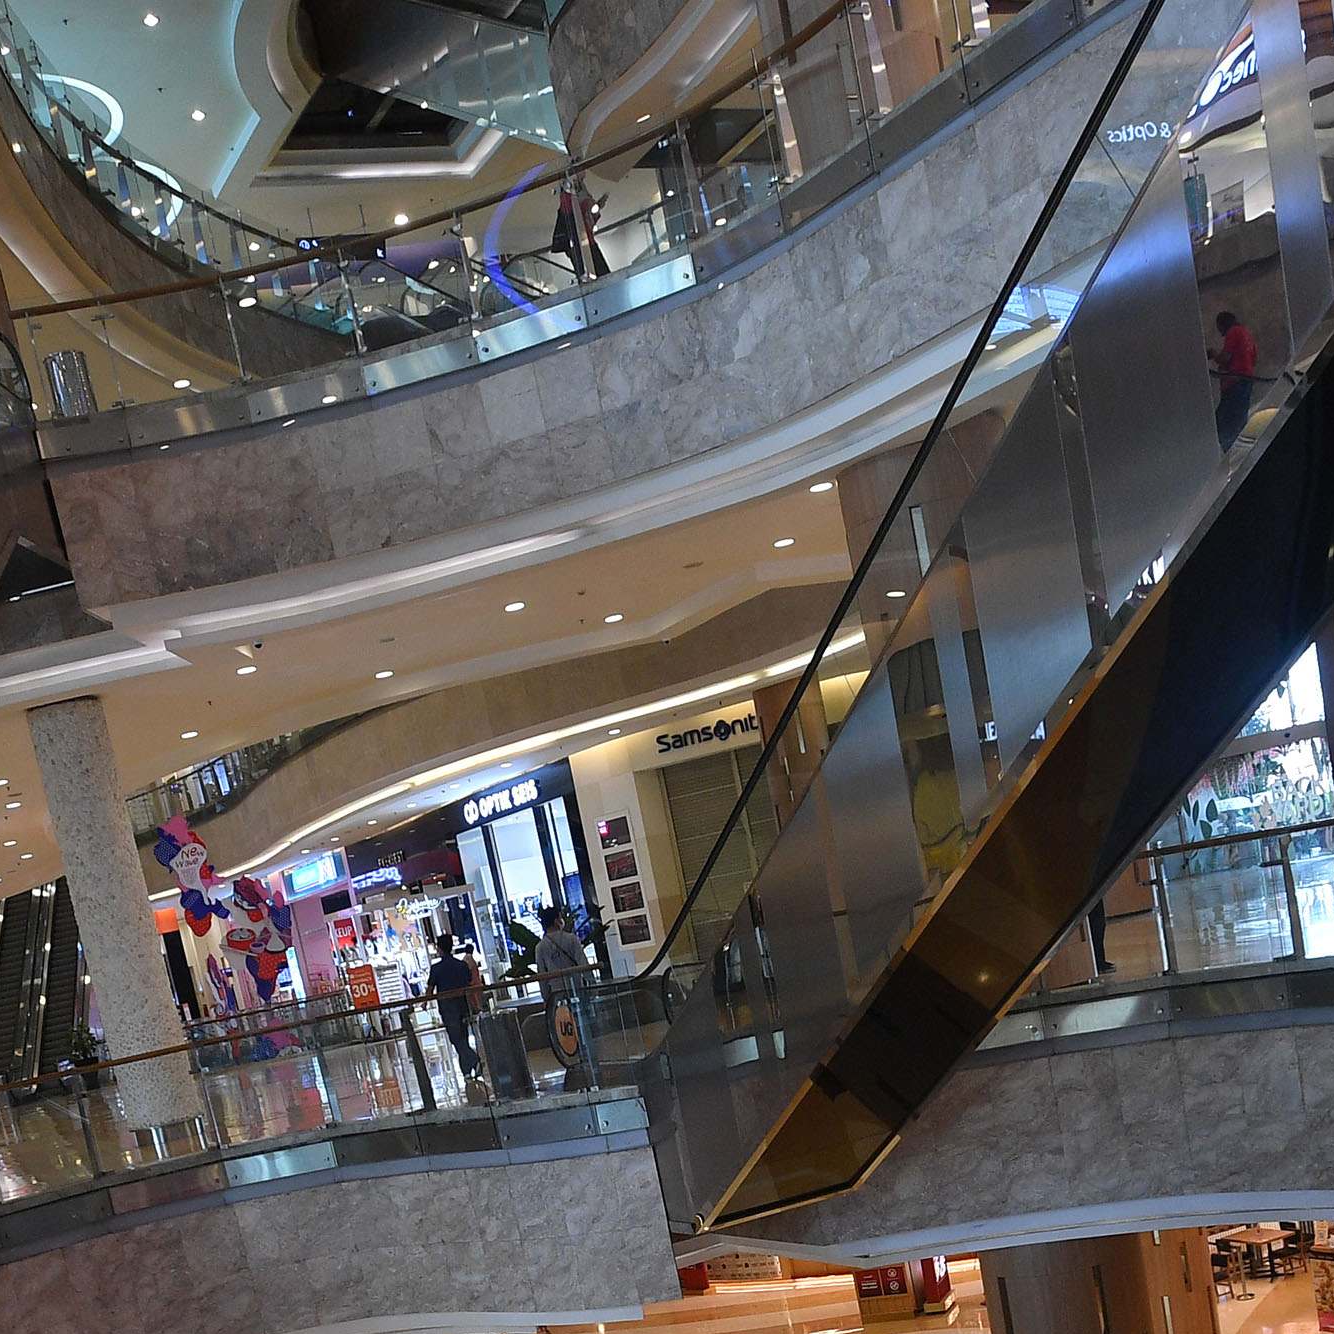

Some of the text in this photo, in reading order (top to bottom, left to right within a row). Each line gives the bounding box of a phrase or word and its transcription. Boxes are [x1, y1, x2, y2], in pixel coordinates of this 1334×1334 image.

[656, 713, 759, 753] Samsonit
[479, 790, 512, 818] OPTIK
[181, 847, 205, 860] New
[175, 858, 199, 869] Wave
[353, 983, 376, 998] 30%
[560, 1021, 573, 1036] UG
